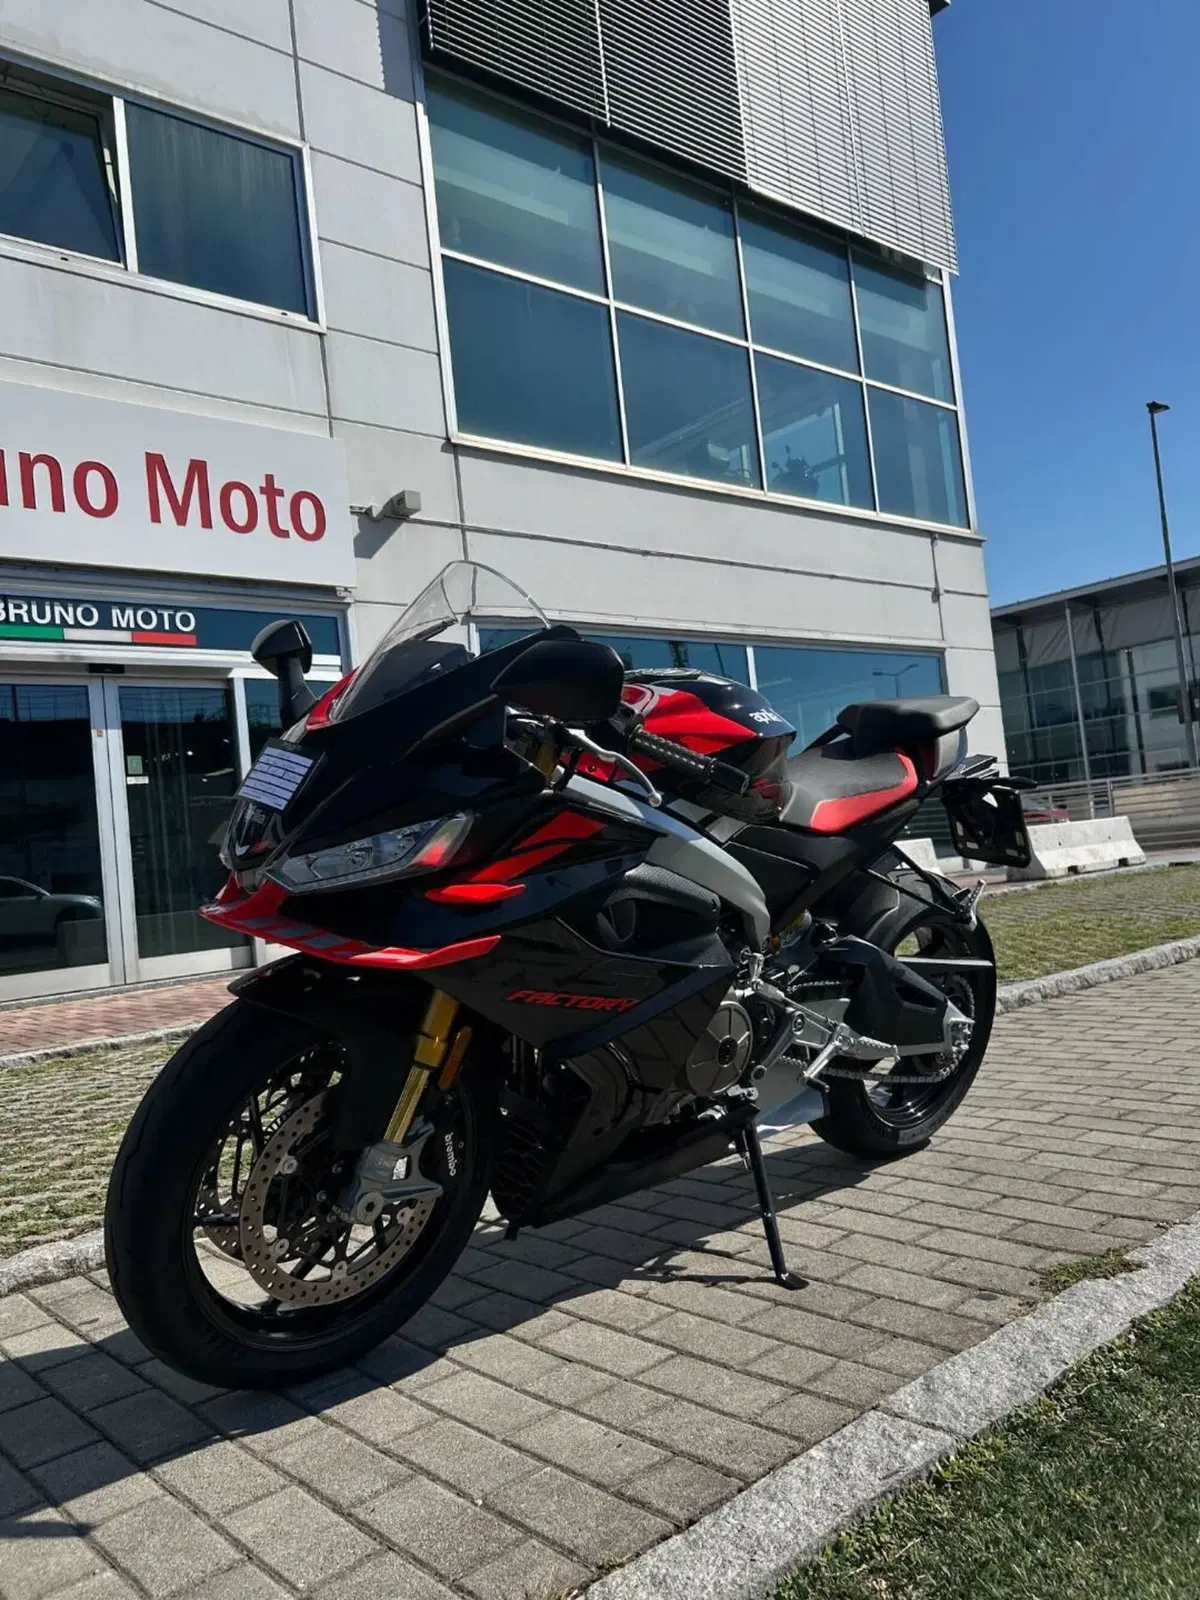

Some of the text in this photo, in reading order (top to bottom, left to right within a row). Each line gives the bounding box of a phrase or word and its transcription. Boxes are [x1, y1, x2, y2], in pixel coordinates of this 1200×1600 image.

[0, 449, 327, 542] no Moto
[111, 606, 196, 632] MOTO
[505, 990, 640, 1012] FACTORY
[444, 1131, 457, 1177] brembo
